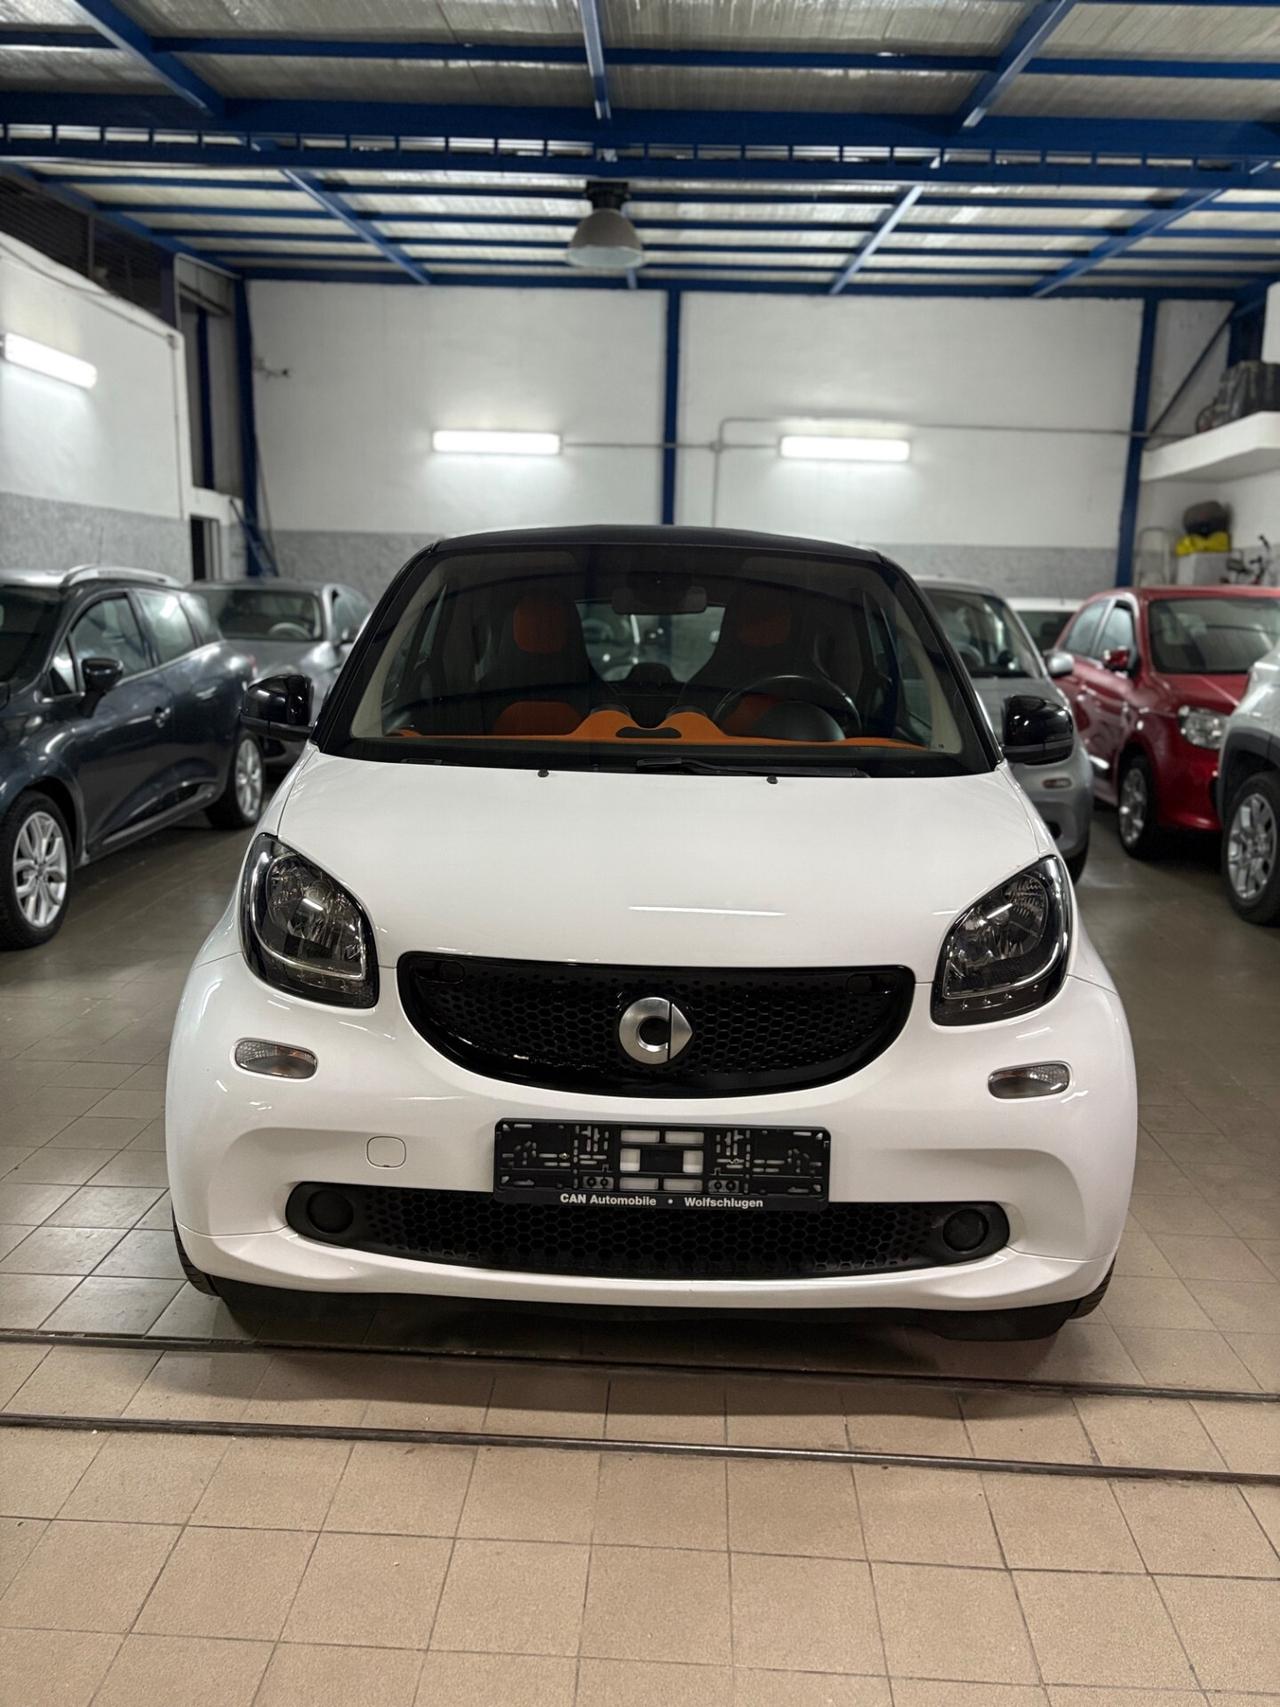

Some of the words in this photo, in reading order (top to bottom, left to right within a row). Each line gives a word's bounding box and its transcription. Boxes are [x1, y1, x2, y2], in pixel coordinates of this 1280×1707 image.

[559, 1193, 587, 1204] CAN
[589, 1194, 657, 1206] Automobile
[684, 1197, 764, 1210] Wolfschlugen
